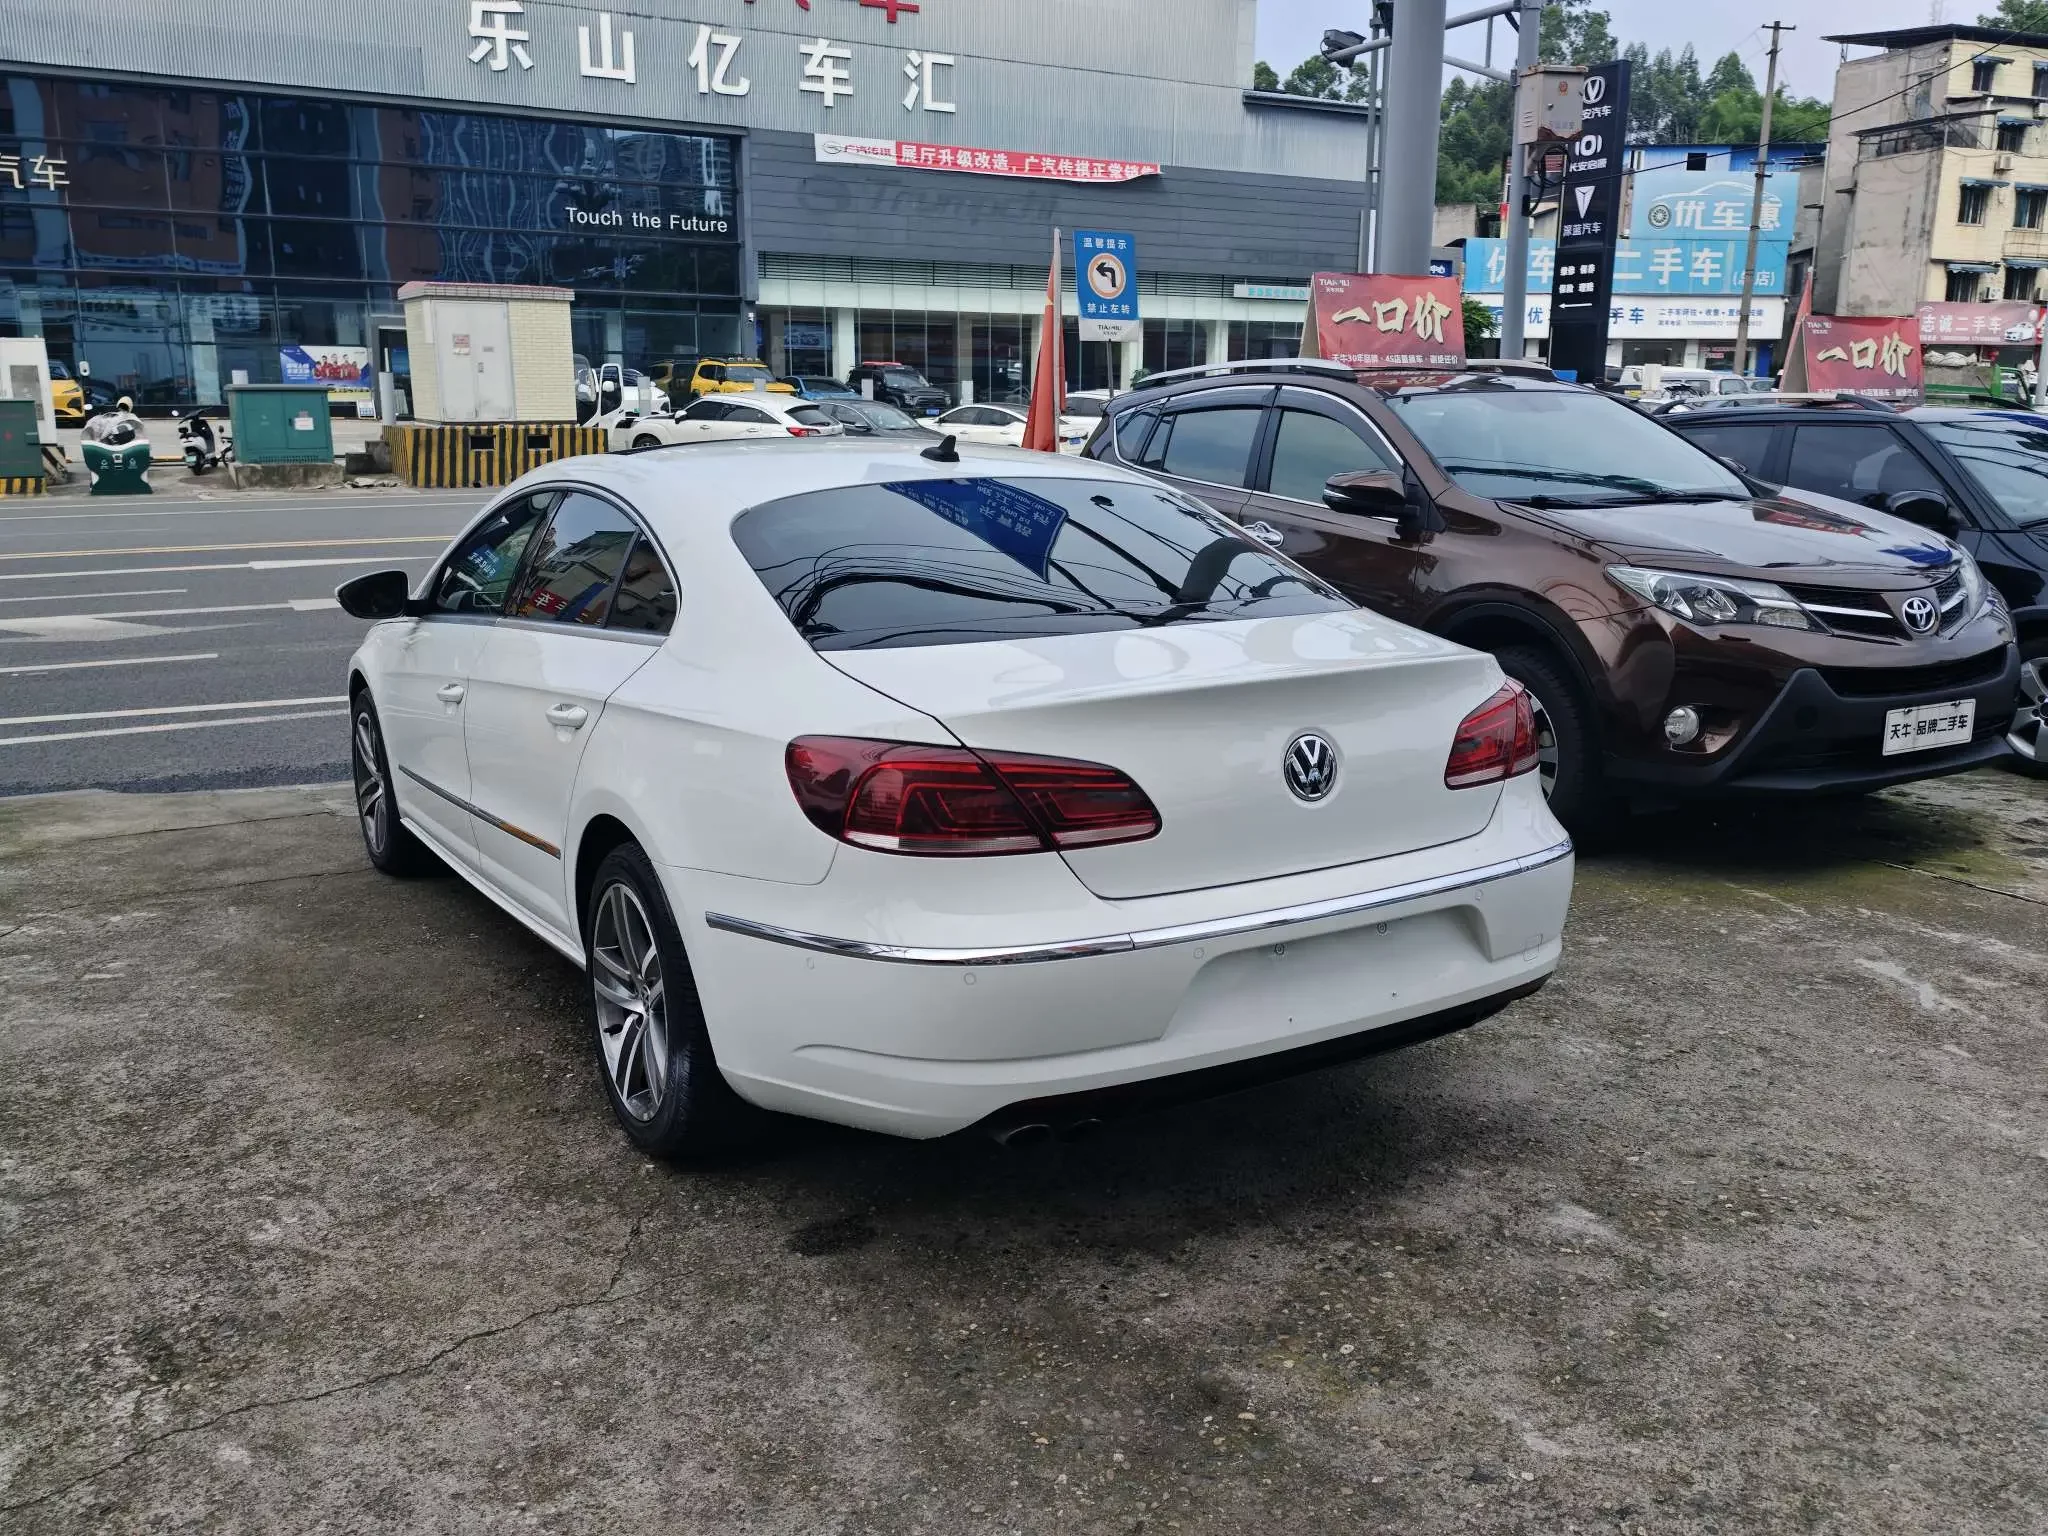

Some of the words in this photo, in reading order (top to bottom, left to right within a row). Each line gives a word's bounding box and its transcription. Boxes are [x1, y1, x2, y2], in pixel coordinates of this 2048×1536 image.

[468, 1, 956, 113] 乐山亿车汇
[1582, 105, 1612, 120] 安汽车
[565, 206, 623, 227] Touch
[632, 212, 662, 229] the
[670, 214, 728, 233] Future
[1563, 221, 1602, 237] 深蓝汽车
[1083, 237, 1127, 250] 温馨提示
[1087, 302, 1131, 314] 禁止左转
[1331, 291, 1452, 344] 一口价
[1816, 331, 1914, 379] 一口价
[1890, 714, 1969, 740] 天牛·品牌二手车
